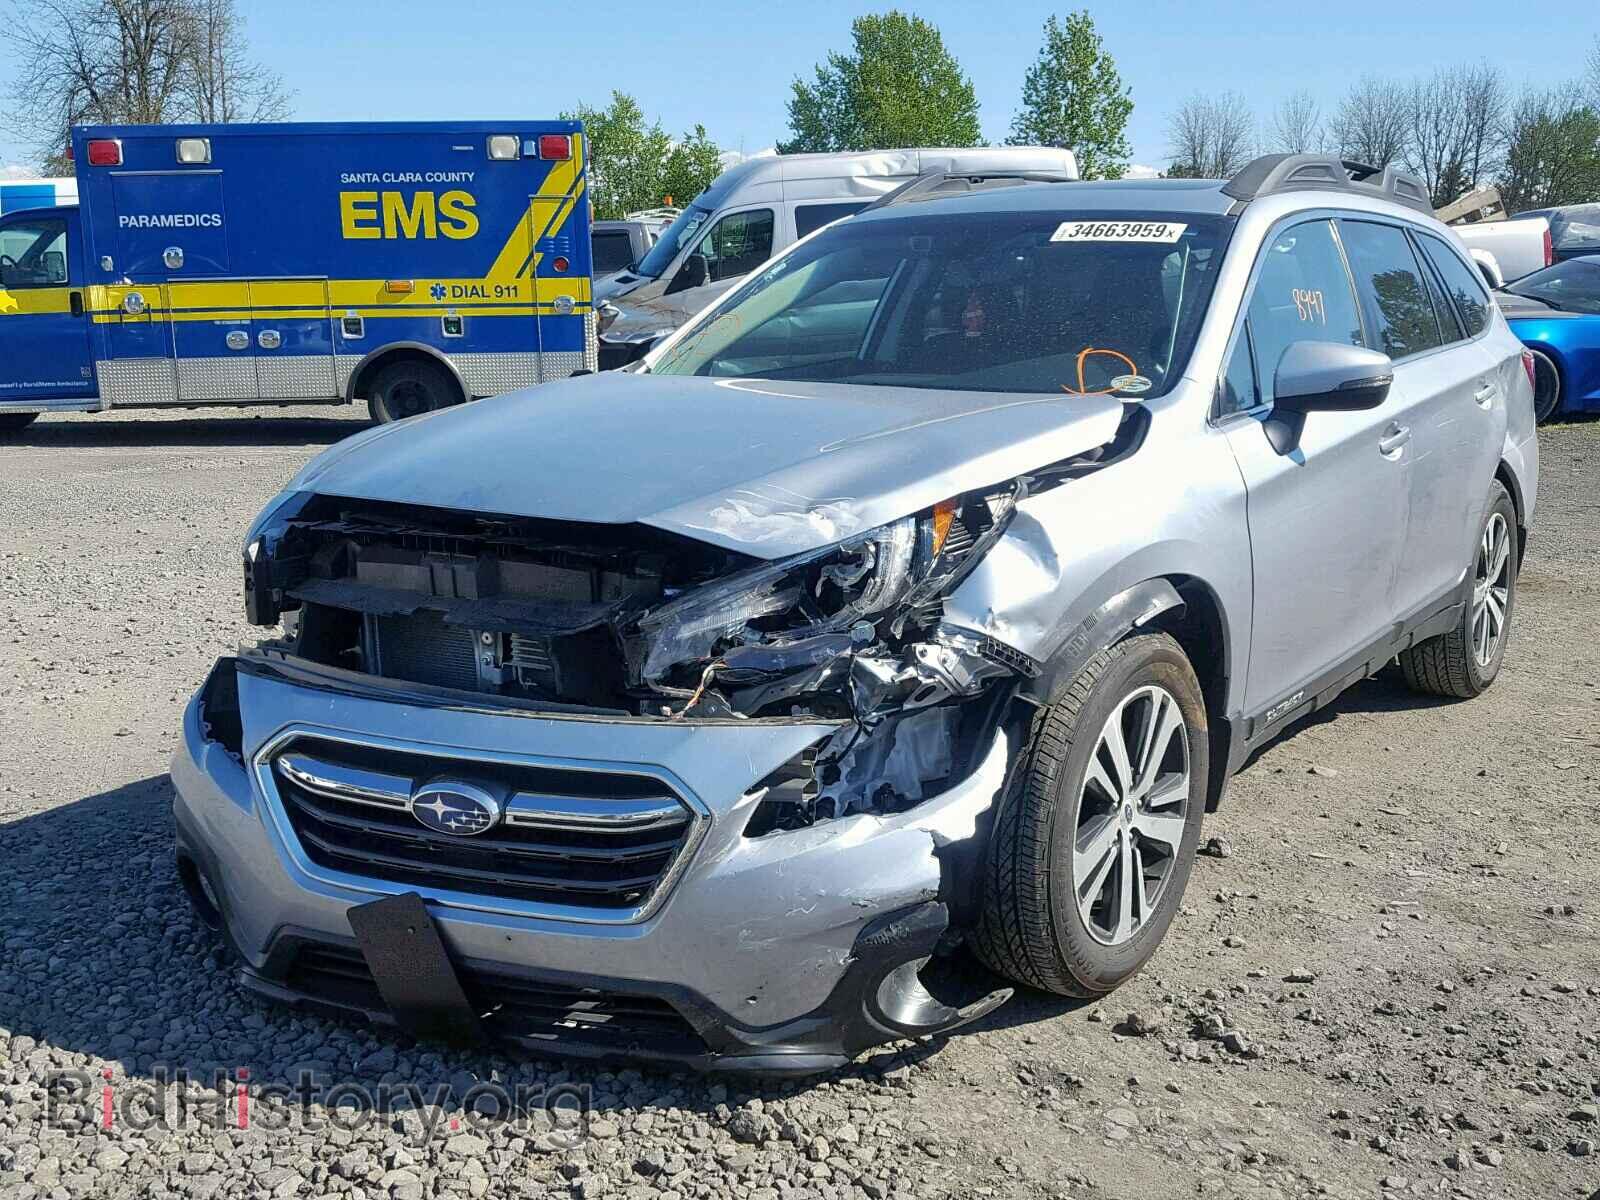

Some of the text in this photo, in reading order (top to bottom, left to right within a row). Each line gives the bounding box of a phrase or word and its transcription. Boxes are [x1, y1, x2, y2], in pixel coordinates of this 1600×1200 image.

[340, 172, 475, 184] SANTA CLARA COUNTY
[118, 213, 222, 228] PARAMEDICS
[339, 190, 480, 239] EMS
[451, 284, 518, 298] DIAL 911
